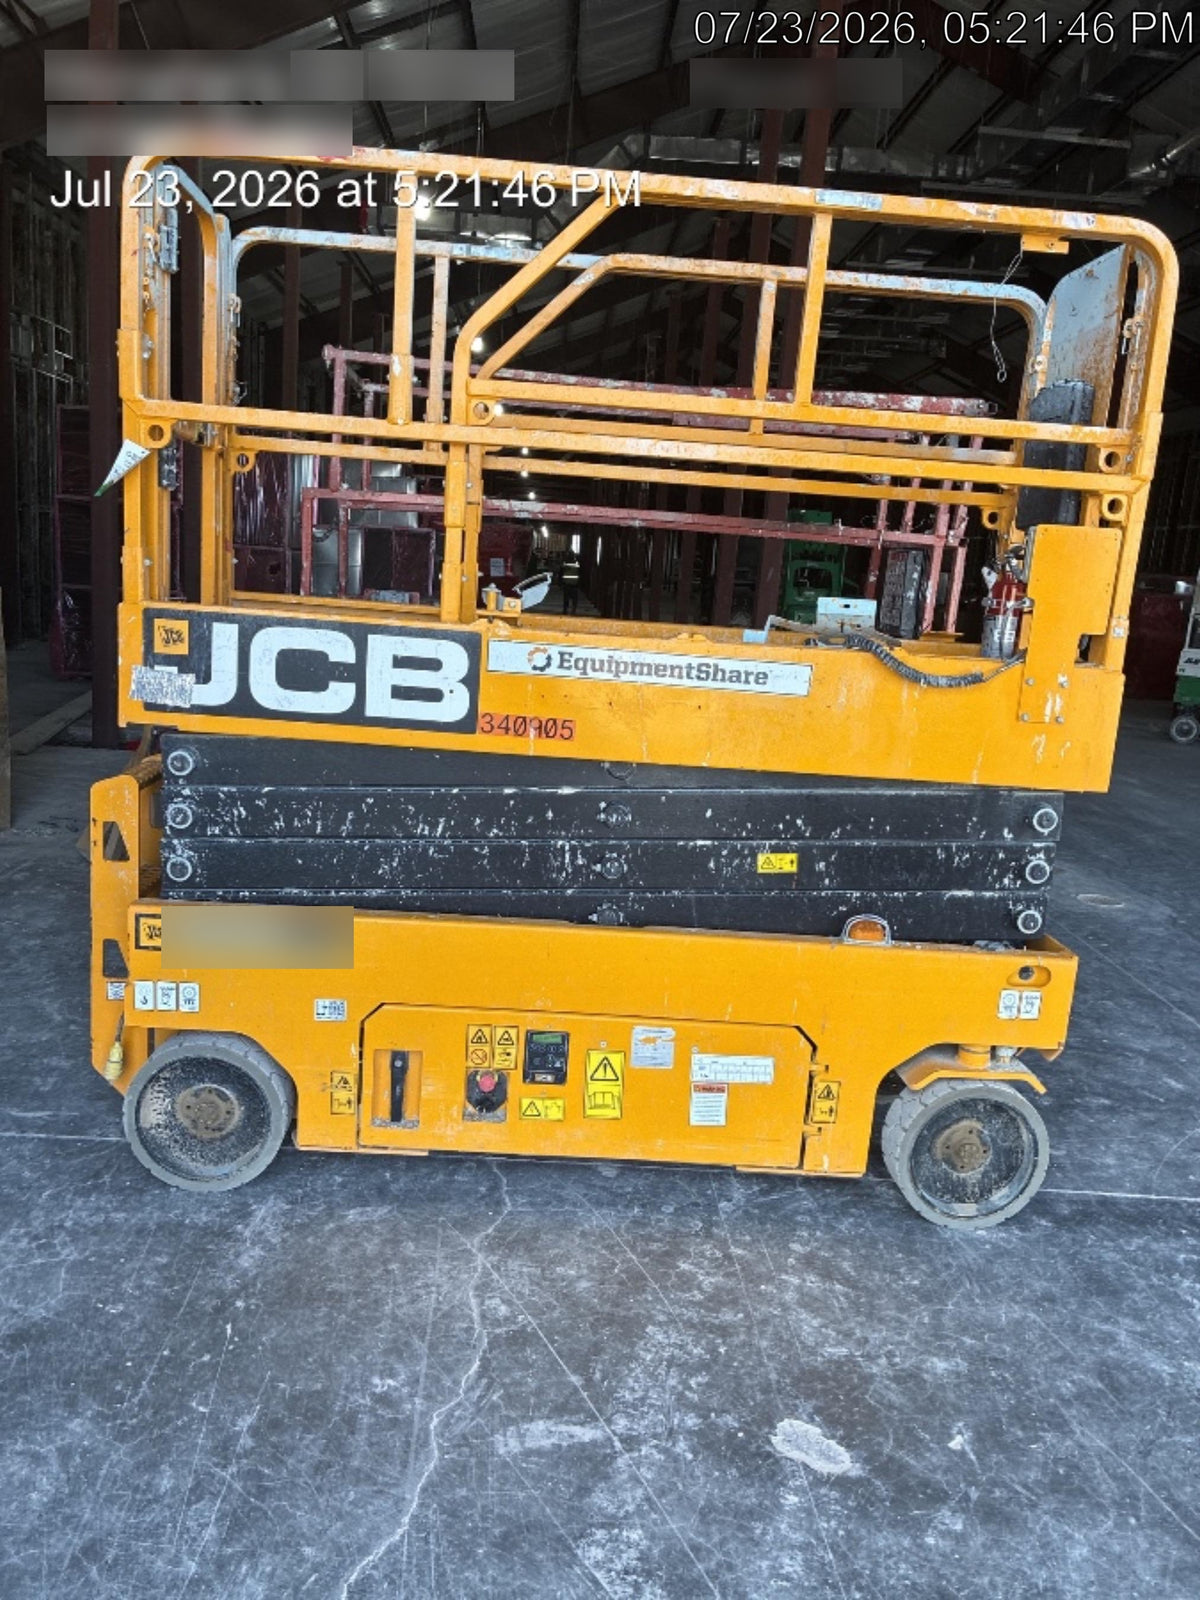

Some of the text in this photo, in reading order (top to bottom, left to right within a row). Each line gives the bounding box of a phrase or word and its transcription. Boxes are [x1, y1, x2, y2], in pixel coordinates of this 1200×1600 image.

[154, 622, 470, 723] JCB
[557, 649, 768, 686] EquipmentShare
[480, 713, 574, 740] 340905
